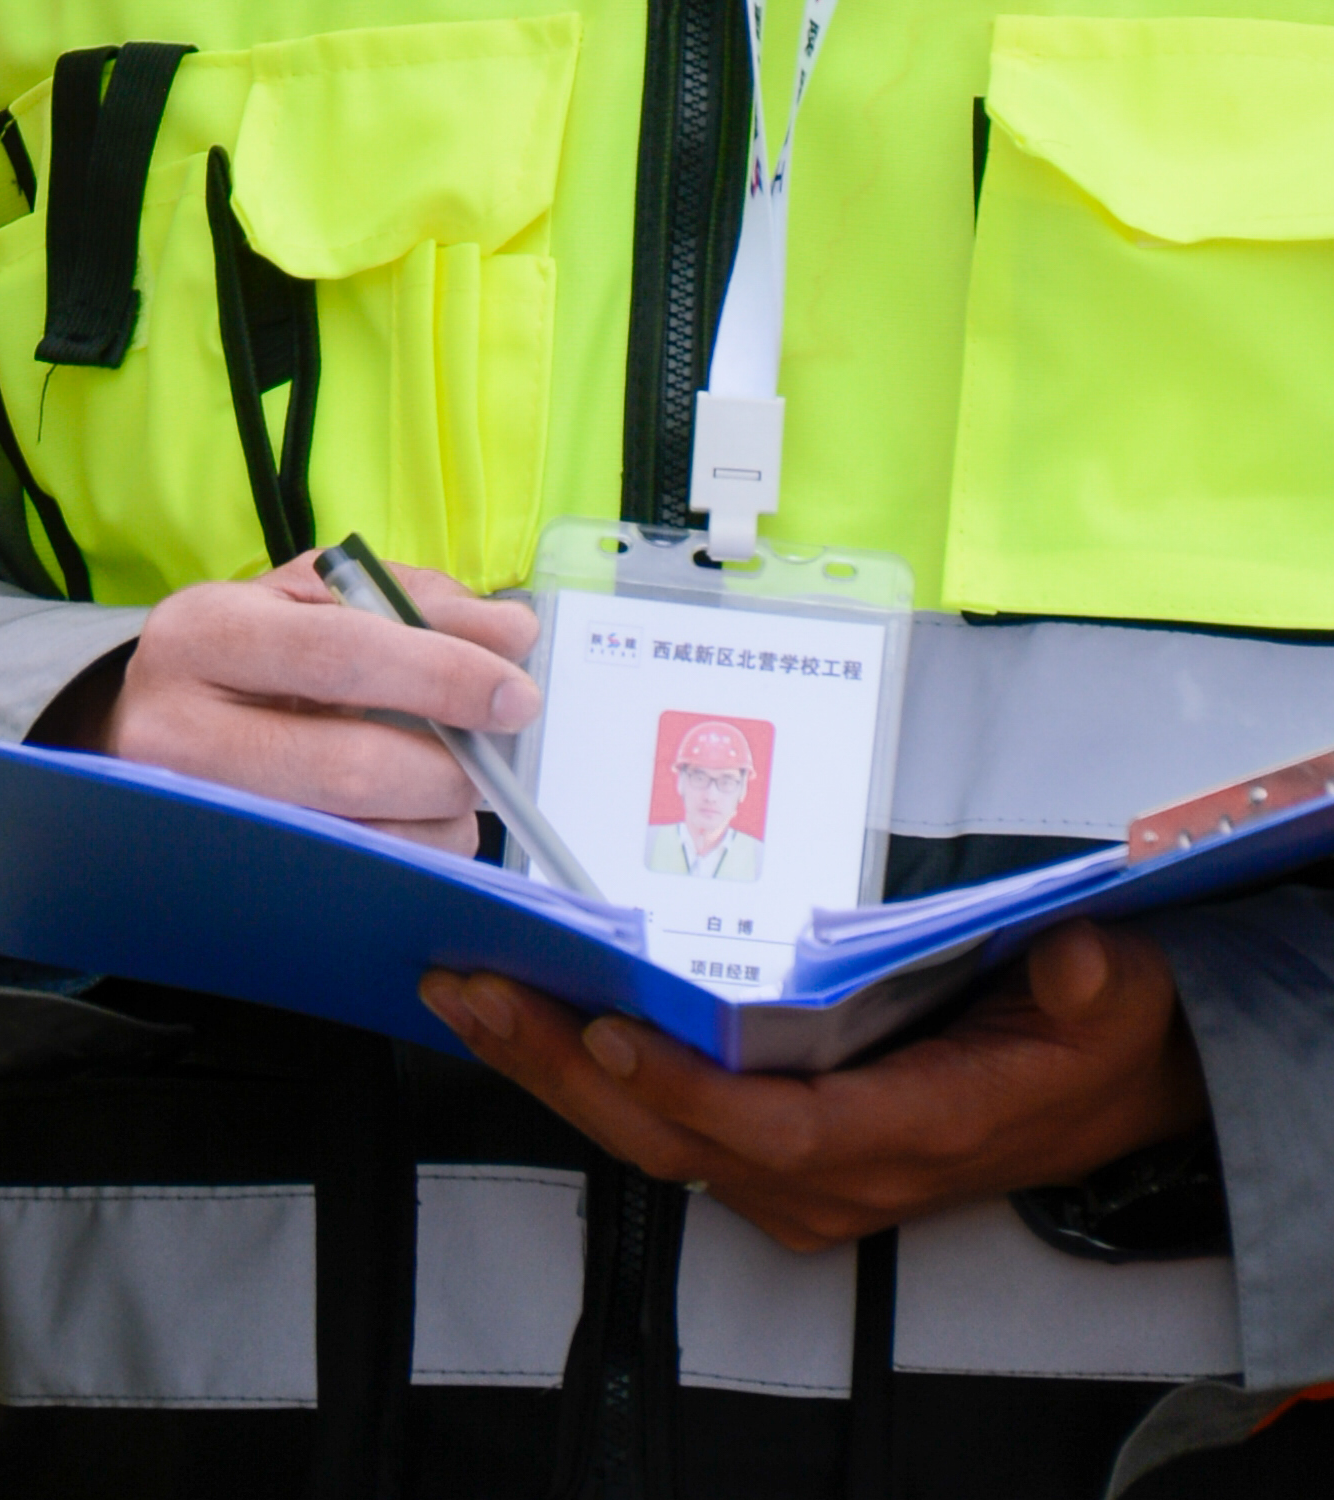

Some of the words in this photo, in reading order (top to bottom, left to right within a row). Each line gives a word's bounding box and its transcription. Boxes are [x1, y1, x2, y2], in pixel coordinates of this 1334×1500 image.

[652, 639, 864, 681] 西咸新区北营学校工程
[690, 959, 761, 982] 项目经理
